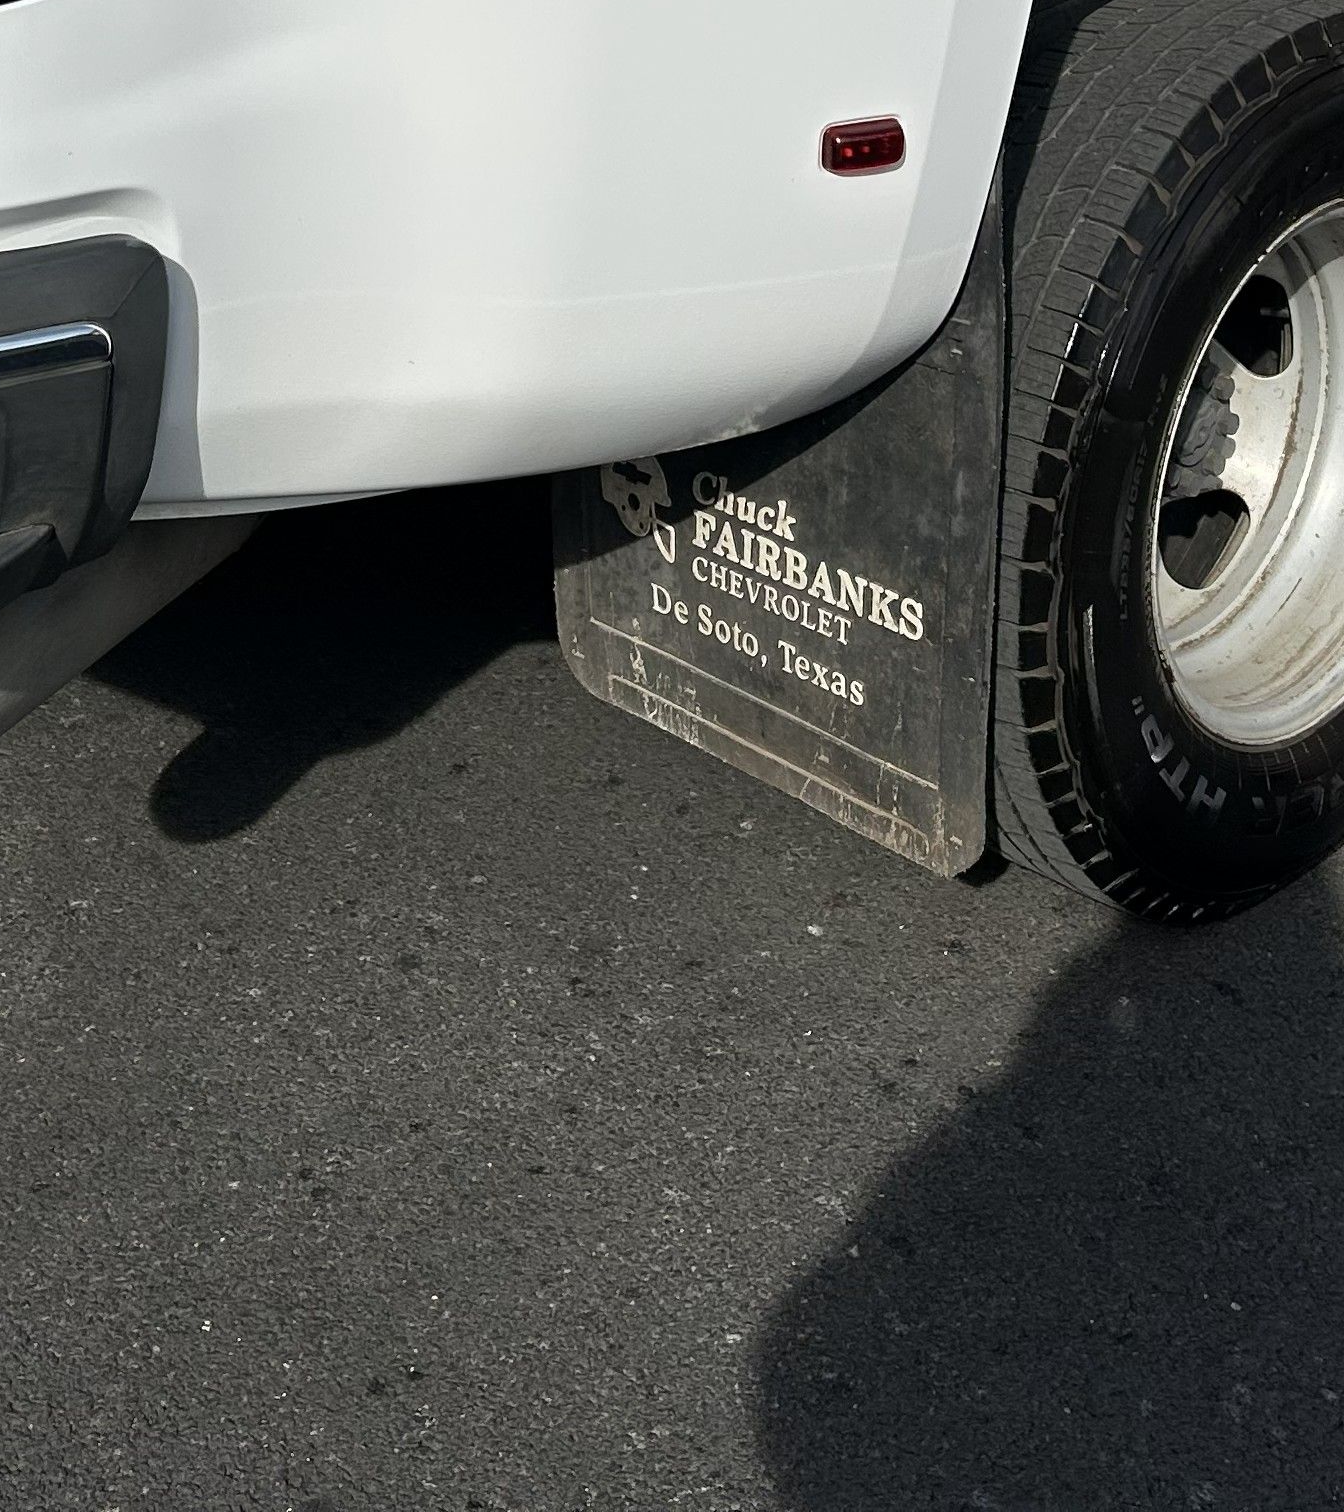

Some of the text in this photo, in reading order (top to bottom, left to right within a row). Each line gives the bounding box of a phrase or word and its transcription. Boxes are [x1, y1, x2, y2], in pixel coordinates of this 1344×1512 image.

[692, 471, 797, 542] Chuck
[691, 510, 925, 641] FAIRBANKS
[691, 556, 852, 646] CHEVROLET
[651, 583, 866, 706] De Soto, Texas
